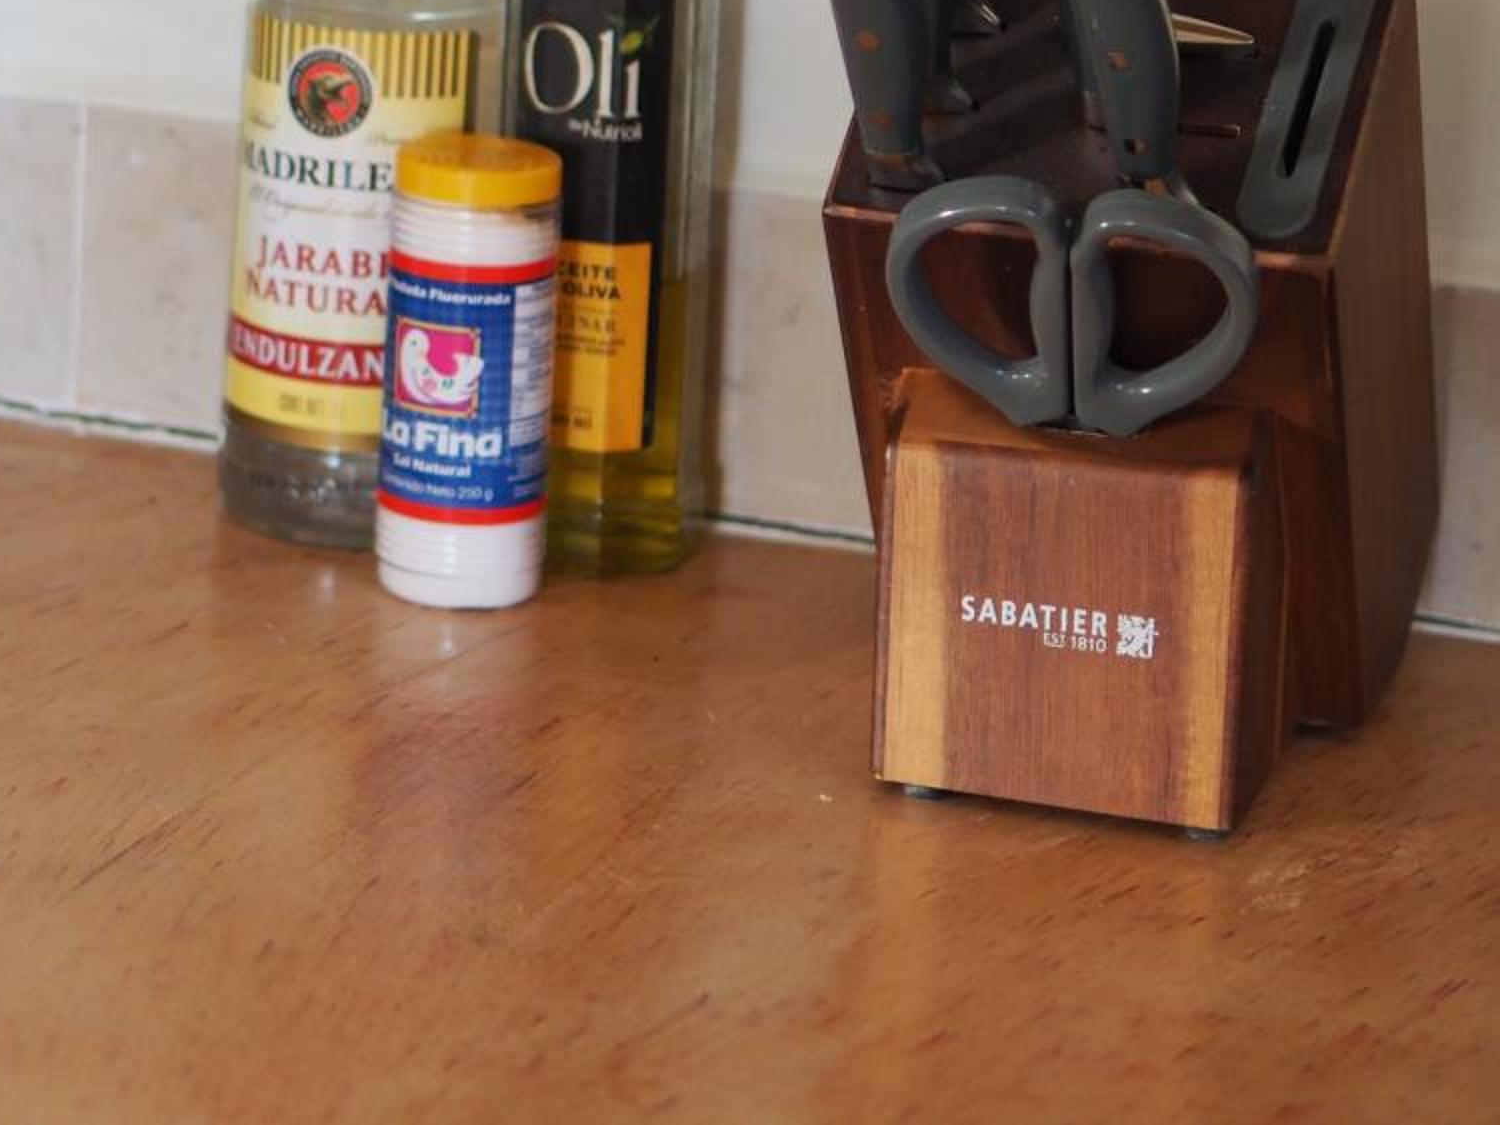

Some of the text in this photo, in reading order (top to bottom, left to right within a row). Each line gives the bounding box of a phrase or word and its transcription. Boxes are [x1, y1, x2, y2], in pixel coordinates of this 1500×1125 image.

[524, 21, 644, 118] Oli
[413, 421, 503, 458] Fina
[413, 458, 472, 478] Natural
[960, 594, 1108, 639] SABATIER
[1070, 635, 1108, 653] 1810
